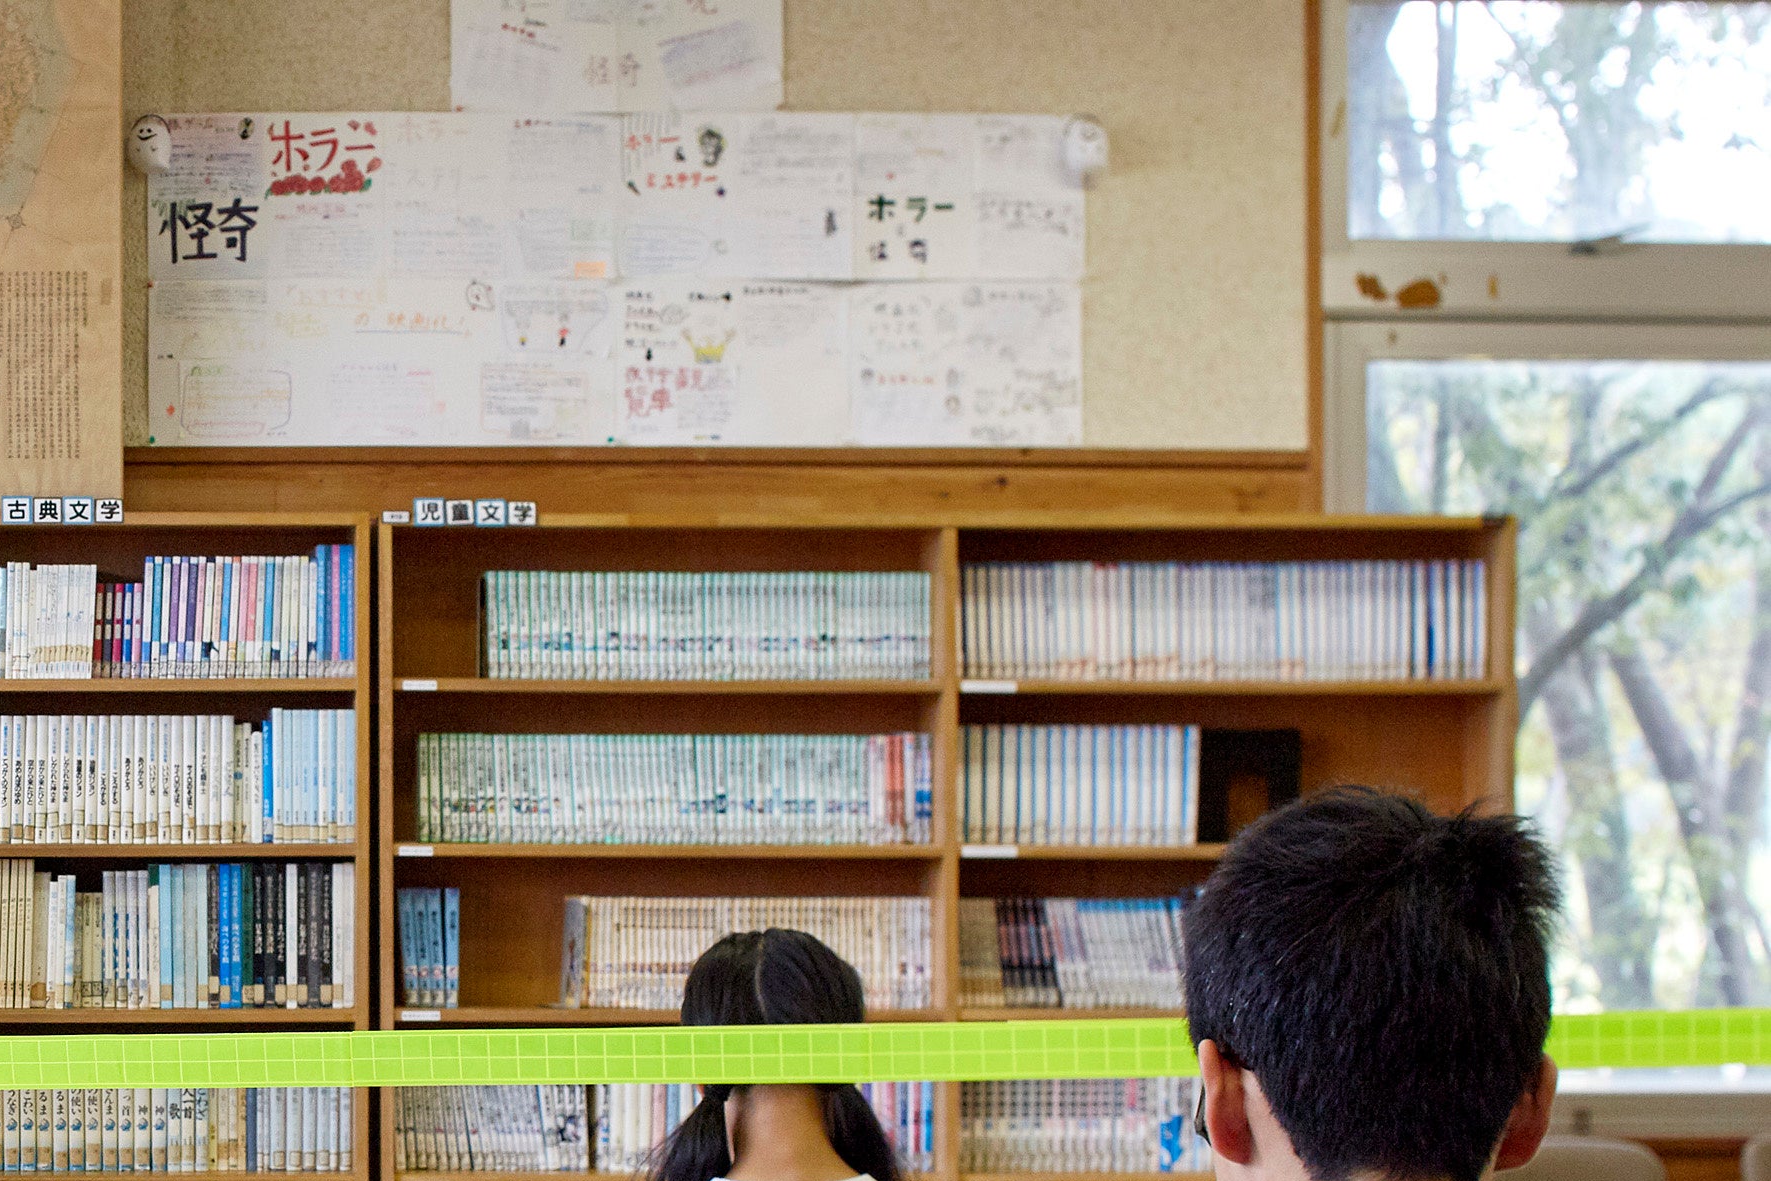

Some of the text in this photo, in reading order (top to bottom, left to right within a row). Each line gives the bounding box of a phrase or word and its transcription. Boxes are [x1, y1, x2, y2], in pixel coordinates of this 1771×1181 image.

[269, 120, 375, 172] ホラー
[869, 195, 955, 222] ホラー
[159, 198, 259, 264] 怪奇
[7, 500, 121, 520] 古典文学
[421, 502, 532, 523] 児童文学
